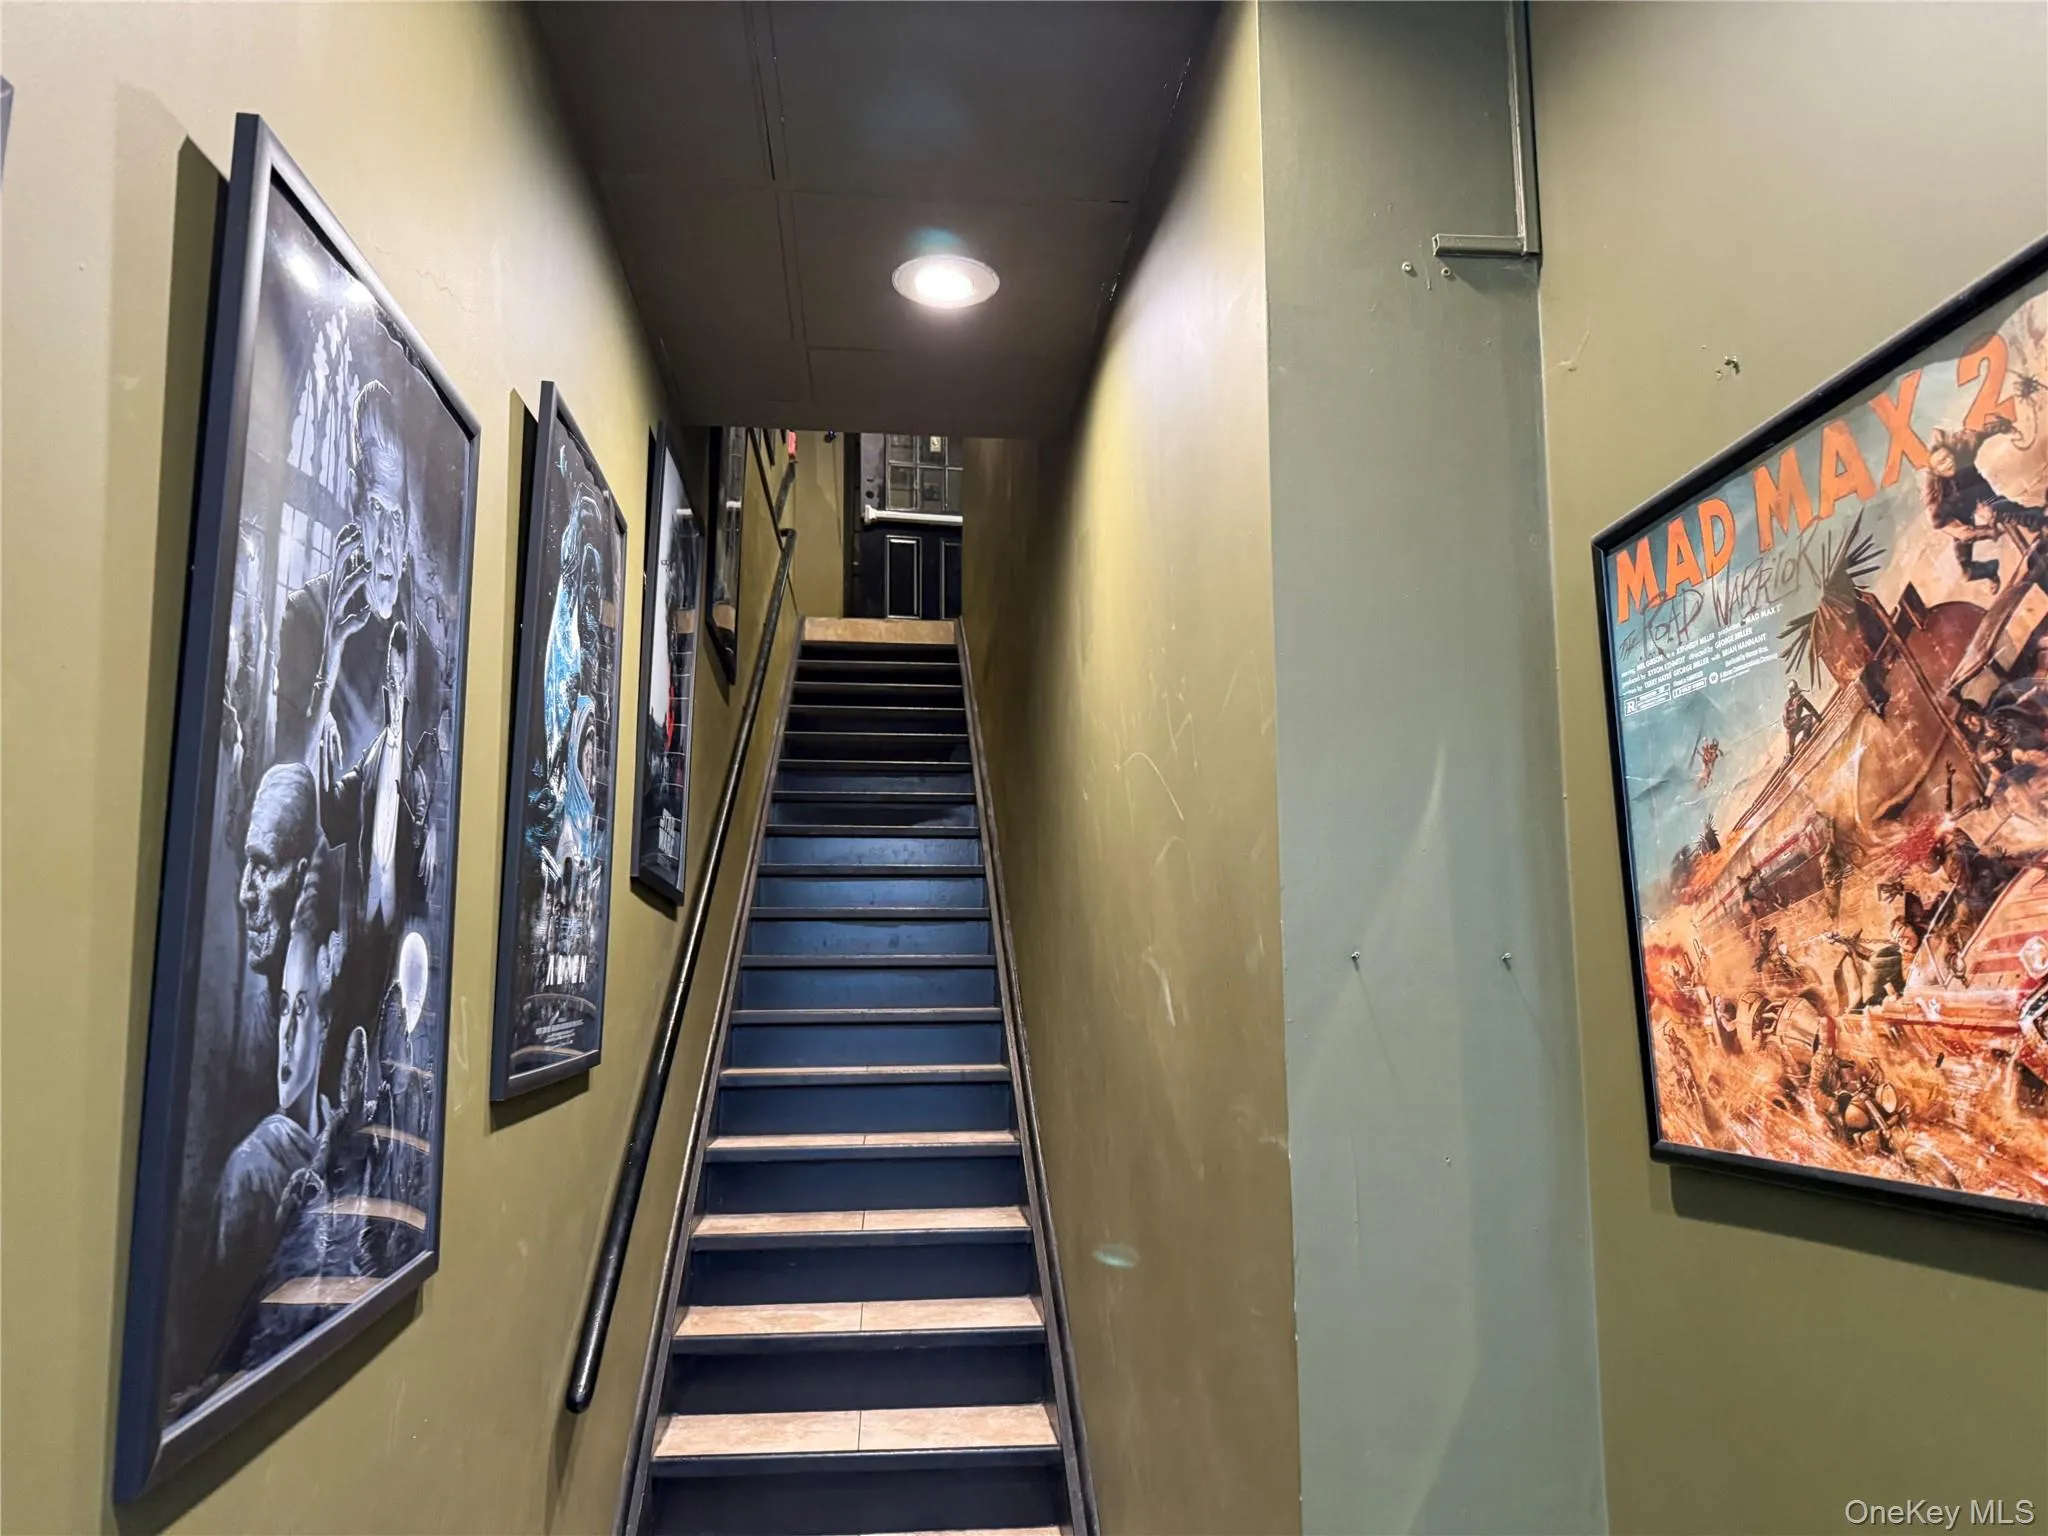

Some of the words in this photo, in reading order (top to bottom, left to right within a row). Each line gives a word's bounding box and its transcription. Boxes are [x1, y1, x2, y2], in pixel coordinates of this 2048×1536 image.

[1616, 498, 1735, 623] MAD
[1754, 371, 1929, 552] MAX
[1958, 333, 2016, 431] 2
[1643, 589, 1705, 661] ROAD
[1760, 606, 1773, 618] MAX
